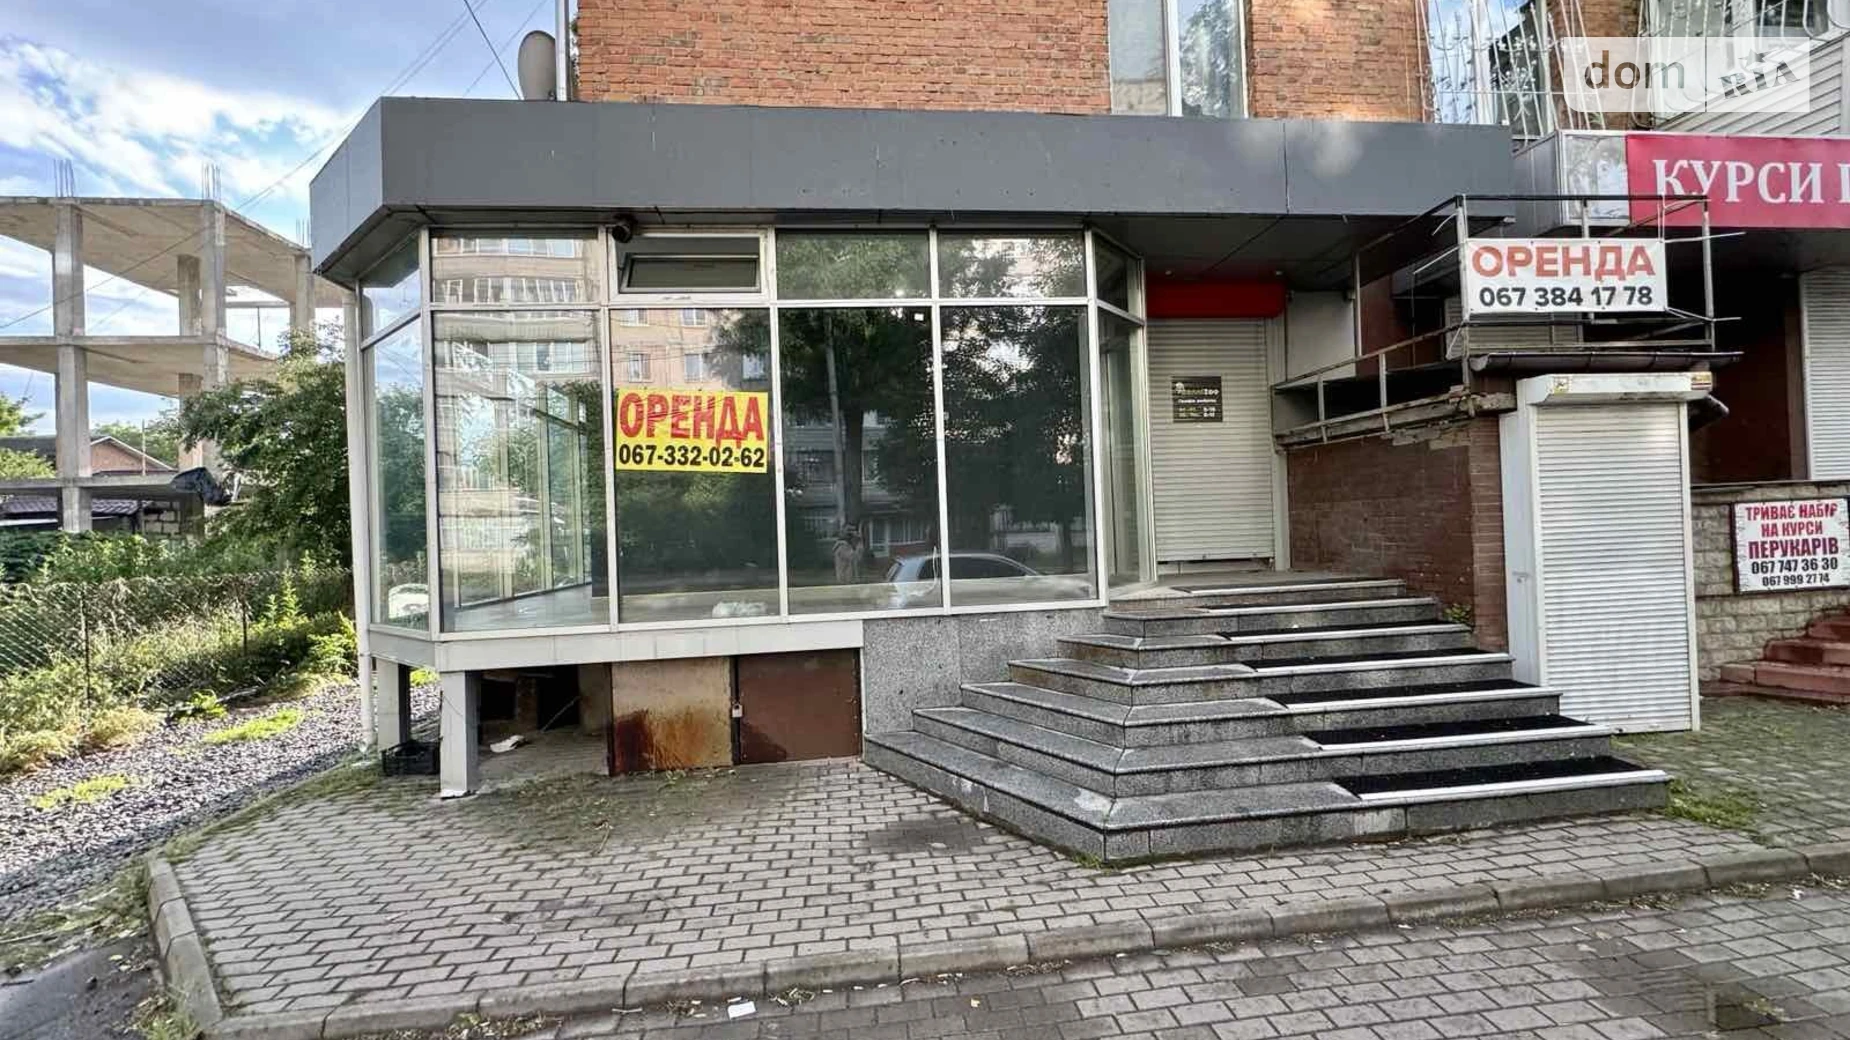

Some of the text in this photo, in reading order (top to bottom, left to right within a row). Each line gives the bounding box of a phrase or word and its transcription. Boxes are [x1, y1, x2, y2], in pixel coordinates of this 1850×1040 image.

[1653, 159, 1824, 204] КУРСИ
[1471, 245, 1656, 282] ОРЕНДА
[1479, 285, 1653, 307] 067 384 17 78
[619, 392, 764, 449] ОРЕНДА
[619, 443, 765, 467] 067-332-02-62
[1745, 505, 1795, 521] ТРИВАЄ
[1761, 520, 1823, 537] НА КУРСИ
[1748, 537, 1839, 559] ПЕРУКАРІВ
[1751, 557, 1838, 574] 067 747 36 30
[1762, 575, 1781, 587] 067
[1783, 574, 1804, 585] 999
[1806, 573, 1817, 584] 27
